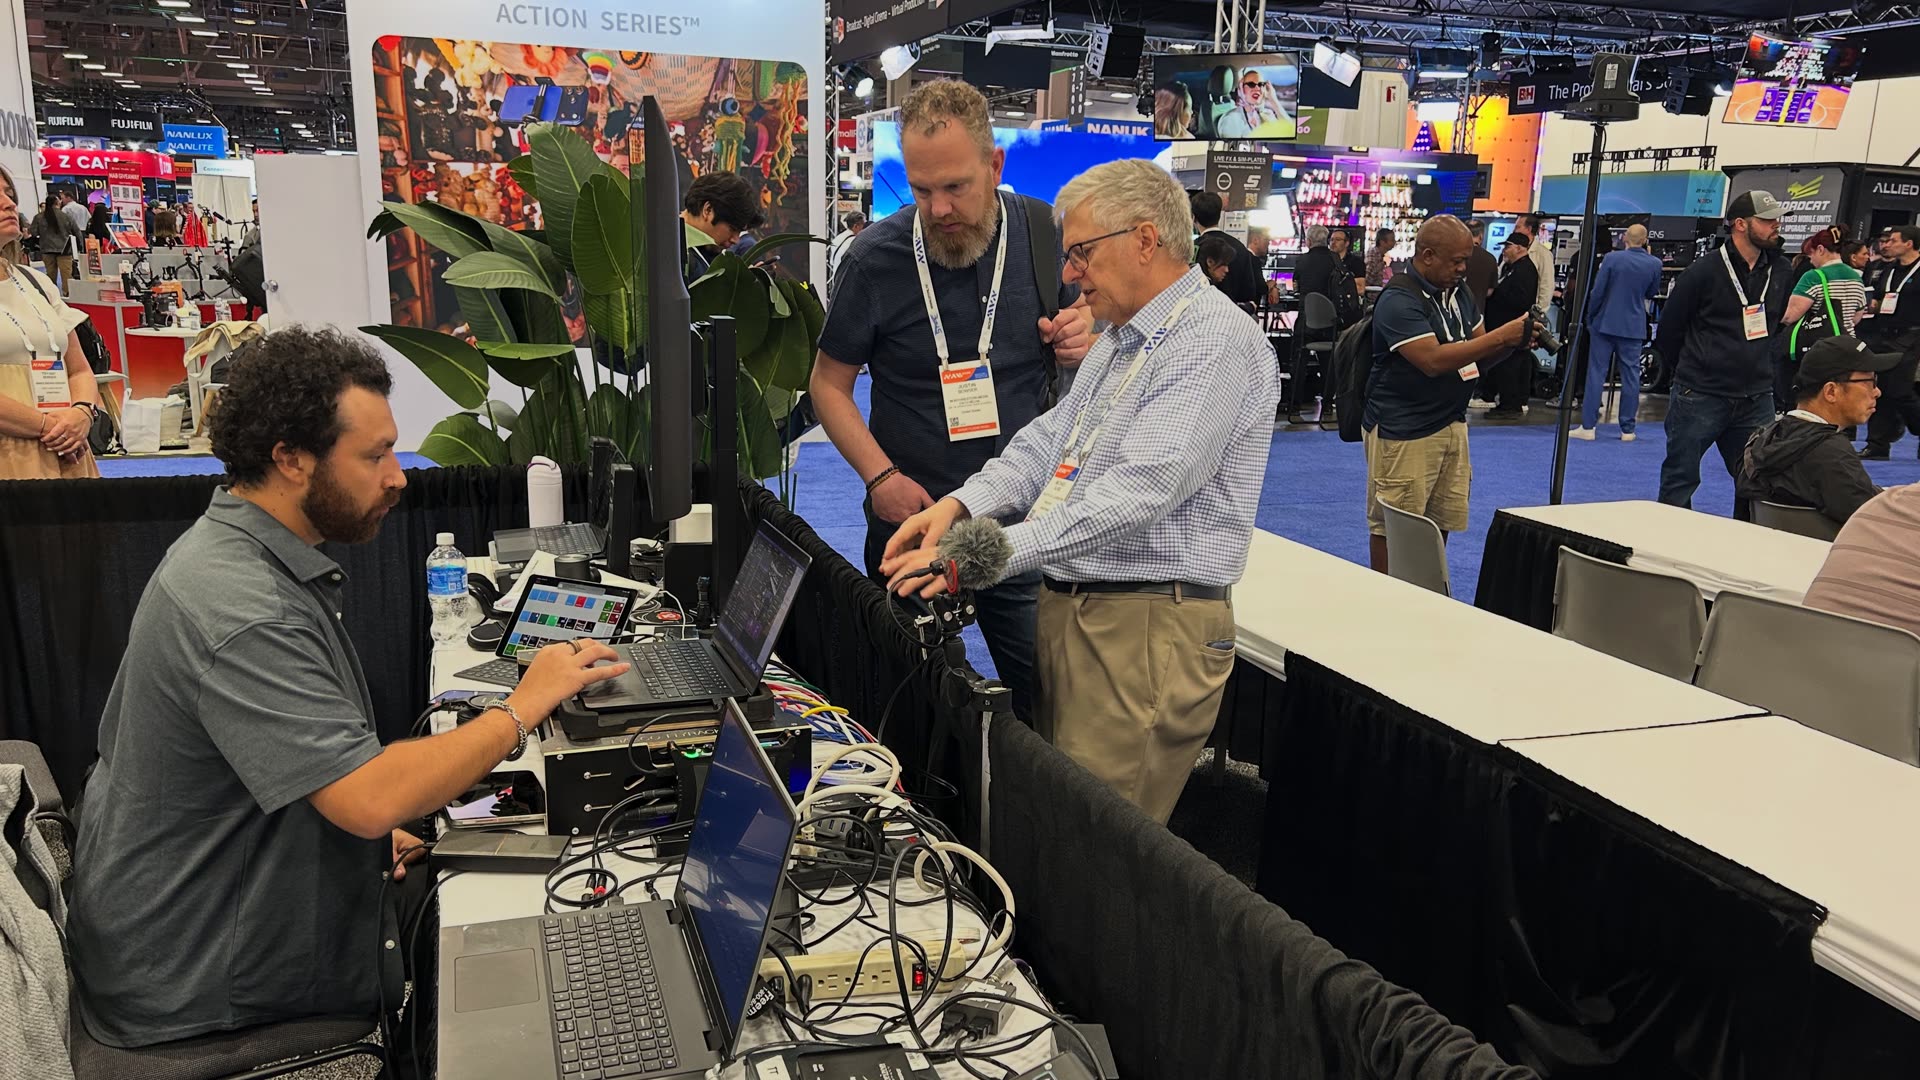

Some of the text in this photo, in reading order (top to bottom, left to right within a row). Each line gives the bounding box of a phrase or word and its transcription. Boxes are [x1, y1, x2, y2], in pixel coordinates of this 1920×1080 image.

[496, 3, 588, 29] ACTION
[1549, 84, 1569, 100] The
[48, 116, 84, 127] FUJIFILM
[111, 119, 154, 131] FUJIFILM
[166, 130, 213, 140] NANLUX
[167, 142, 214, 152] NANLITE
[58, 155, 71, 168] Z
[85, 179, 107, 190] NDI
[1872, 182, 1920, 196] ALLIED
[1785, 215, 1798, 223] USED
[1798, 215, 1816, 223] MOBILE
[1816, 215, 1832, 223] UNITS
[1785, 225, 1807, 233] UPGRADE
